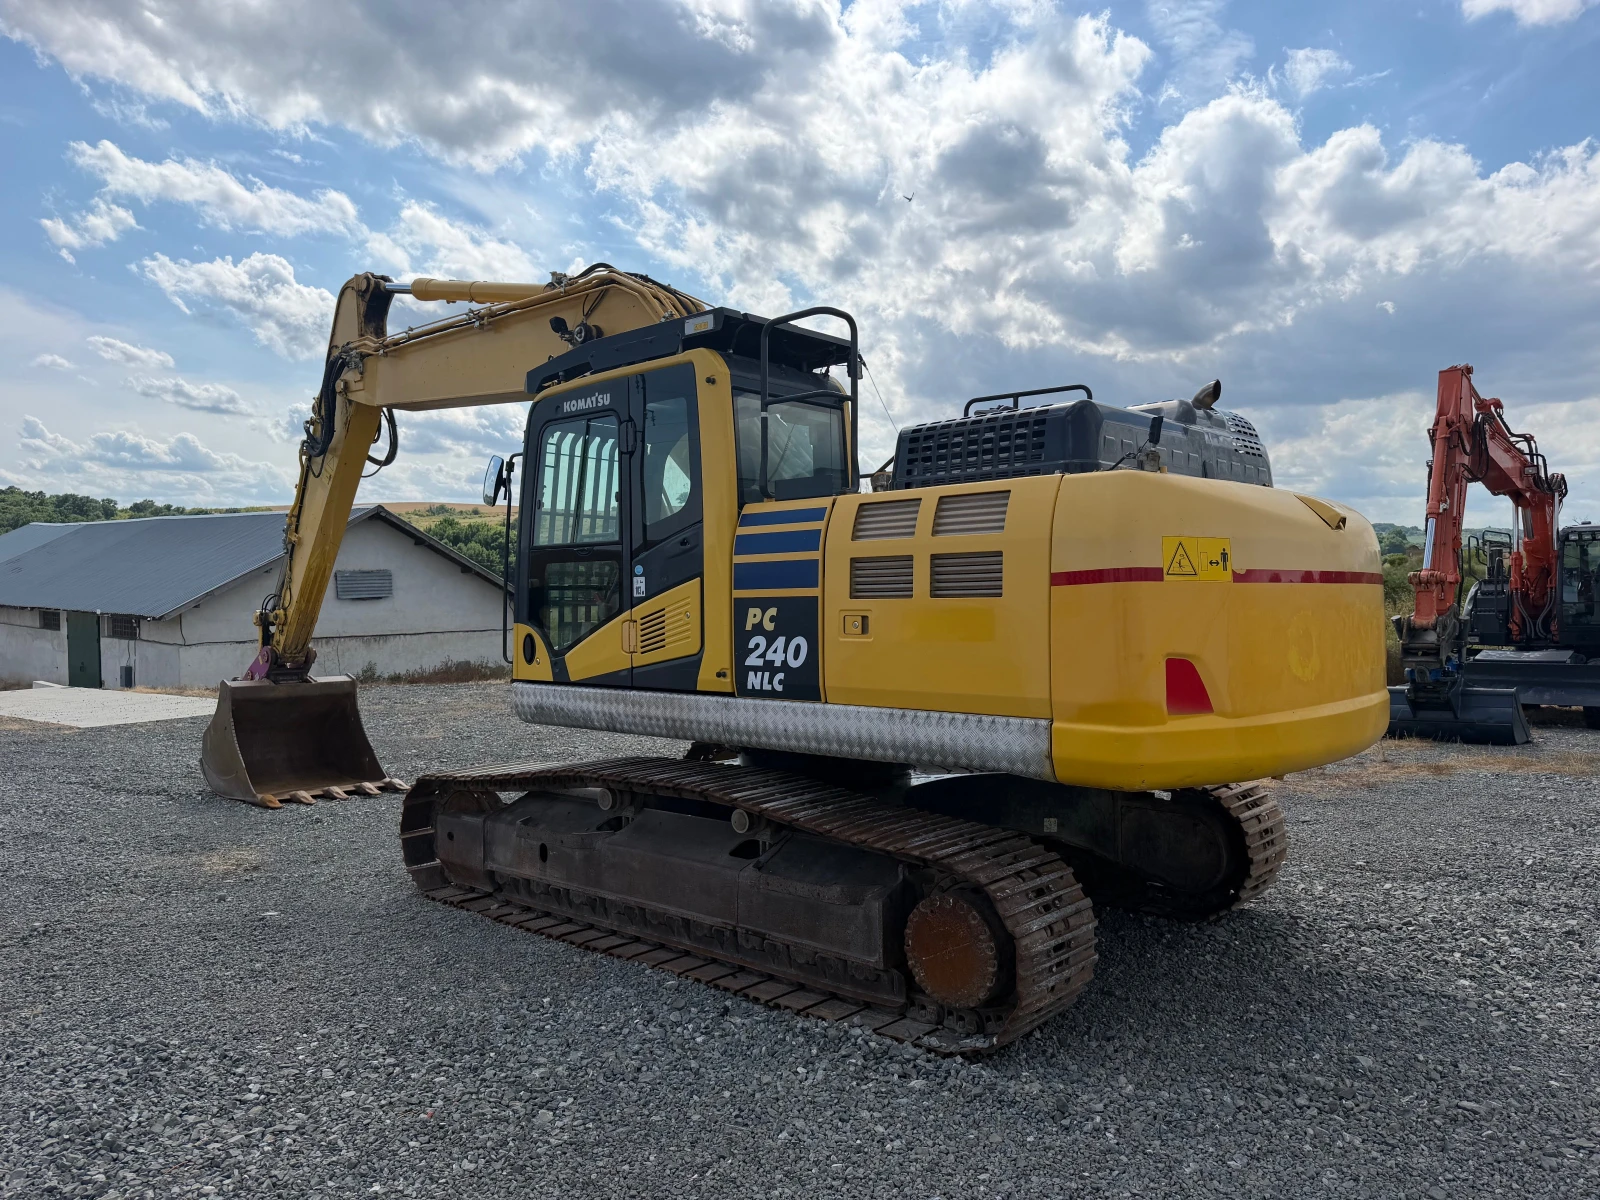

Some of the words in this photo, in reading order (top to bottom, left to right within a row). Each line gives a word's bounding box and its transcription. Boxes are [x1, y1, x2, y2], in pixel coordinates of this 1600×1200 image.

[563, 392, 611, 413] KOMATSU
[745, 607, 778, 631] PC
[744, 635, 808, 668] 240
[747, 671, 785, 691] NLC
